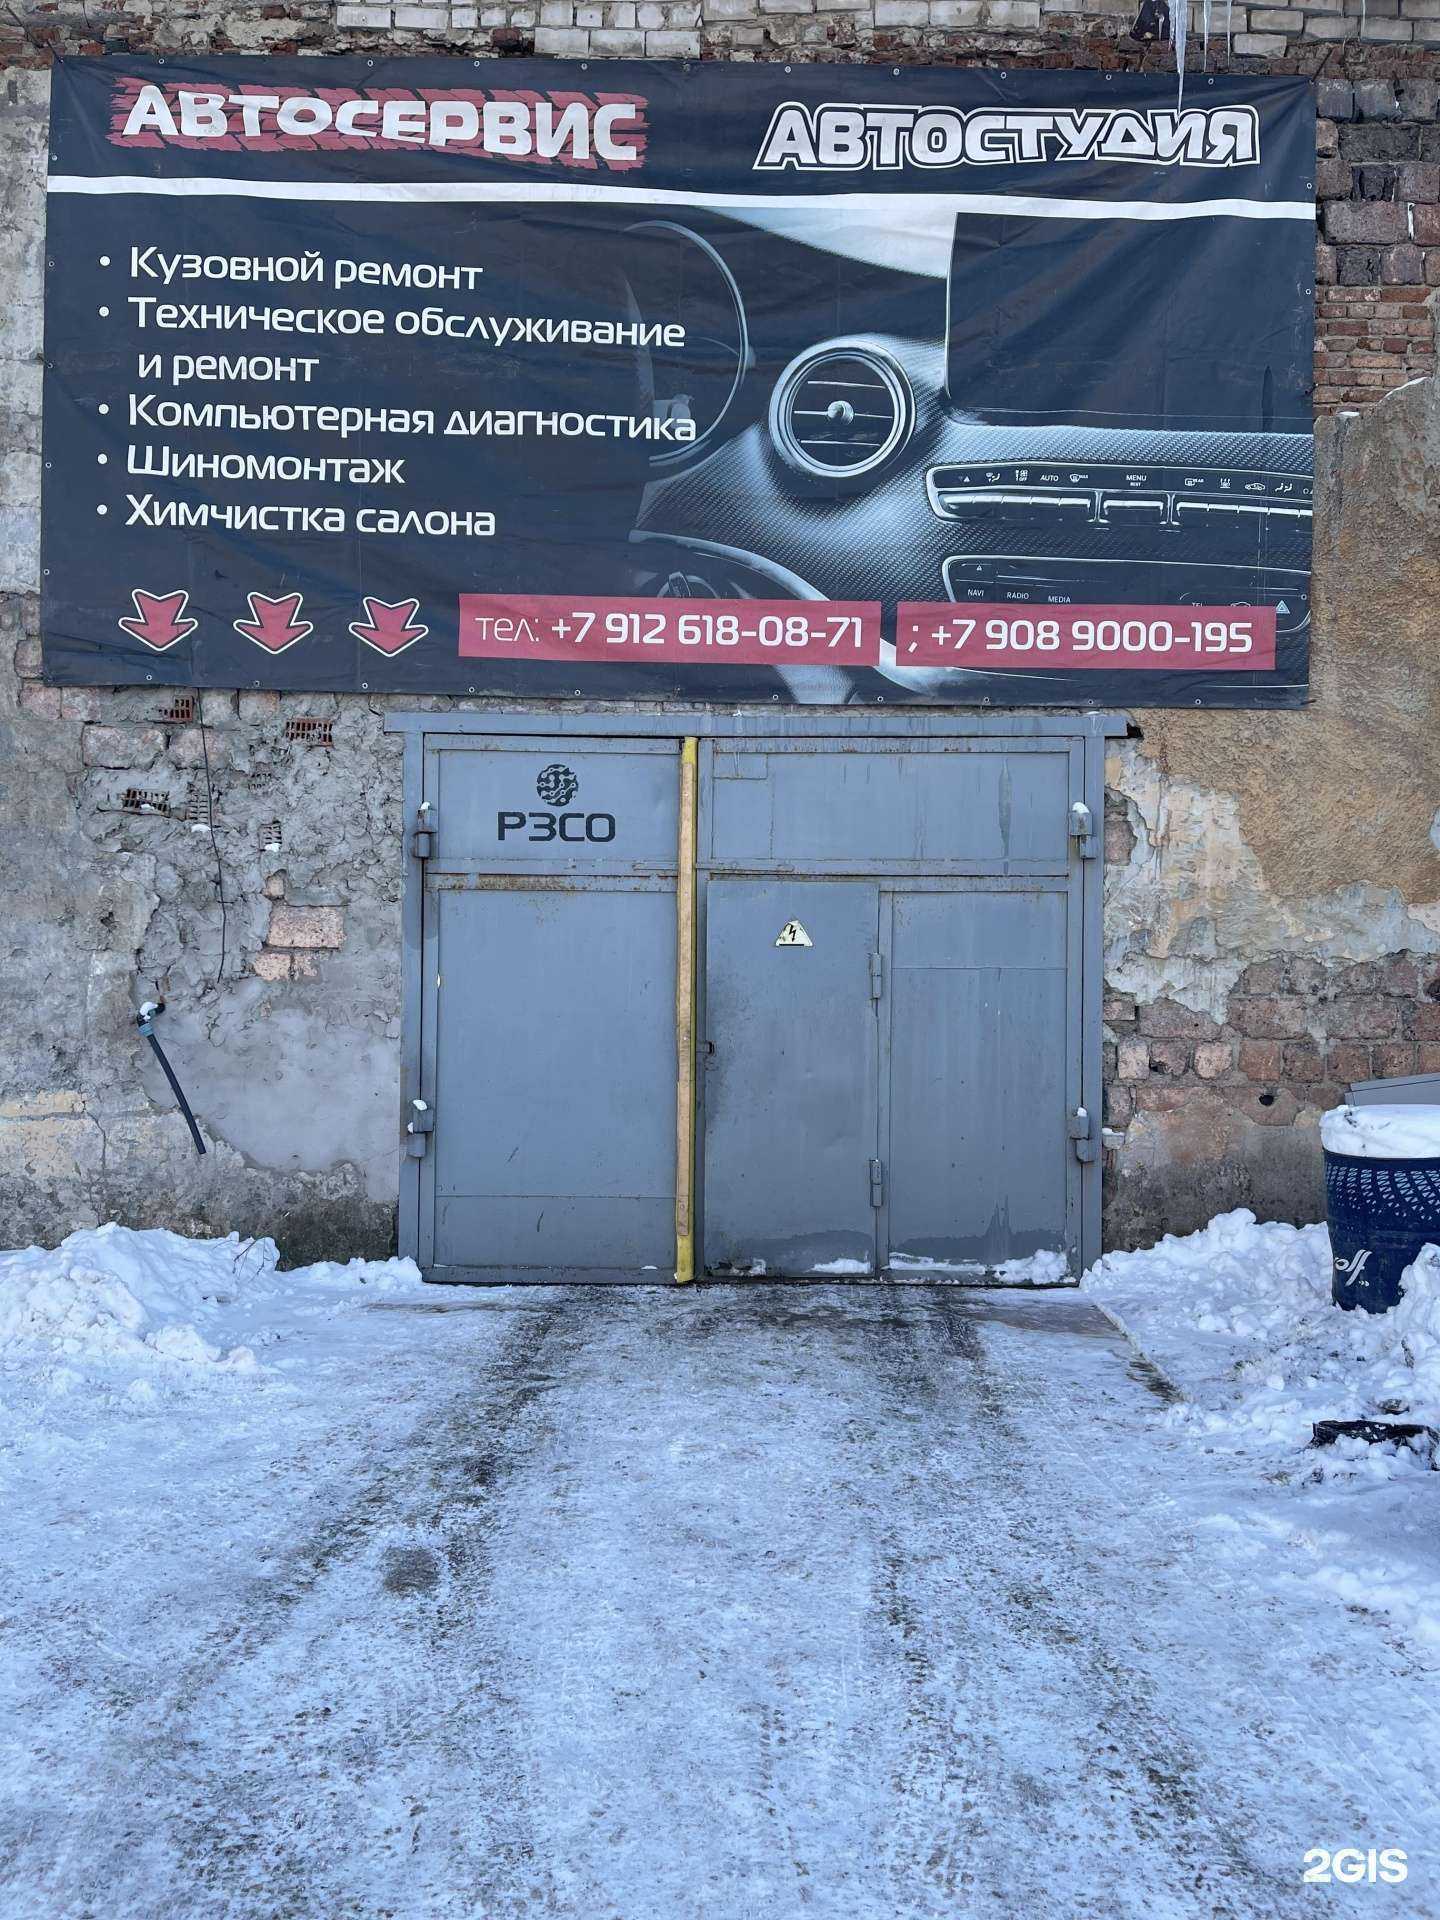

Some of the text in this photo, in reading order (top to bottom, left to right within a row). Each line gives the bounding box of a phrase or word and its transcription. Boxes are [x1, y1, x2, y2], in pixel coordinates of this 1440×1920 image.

[121, 84, 639, 162] АВТОСЕРВИС
[752, 101, 1260, 171] АВТОСТУДИЯ
[130, 246, 484, 290] Кузовной ремонт
[128, 297, 686, 347] Техническое обслуживание
[139, 354, 320, 386] и ремонт
[129, 394, 697, 441] Компьютерная диагностика
[128, 445, 406, 484] Шиномонтаж
[1126, 474, 1147, 482] MENU
[125, 494, 496, 536] Химчистка салона
[967, 588, 985, 597] NAVI
[1006, 592, 1030, 600] RADIO
[1048, 595, 1071, 604] MEDIA
[475, 612, 862, 648] тел: +7 912 618-08-71
[931, 620, 977, 649] +7
[985, 619, 1060, 651] 908
[1072, 621, 1253, 653] 9000-195
